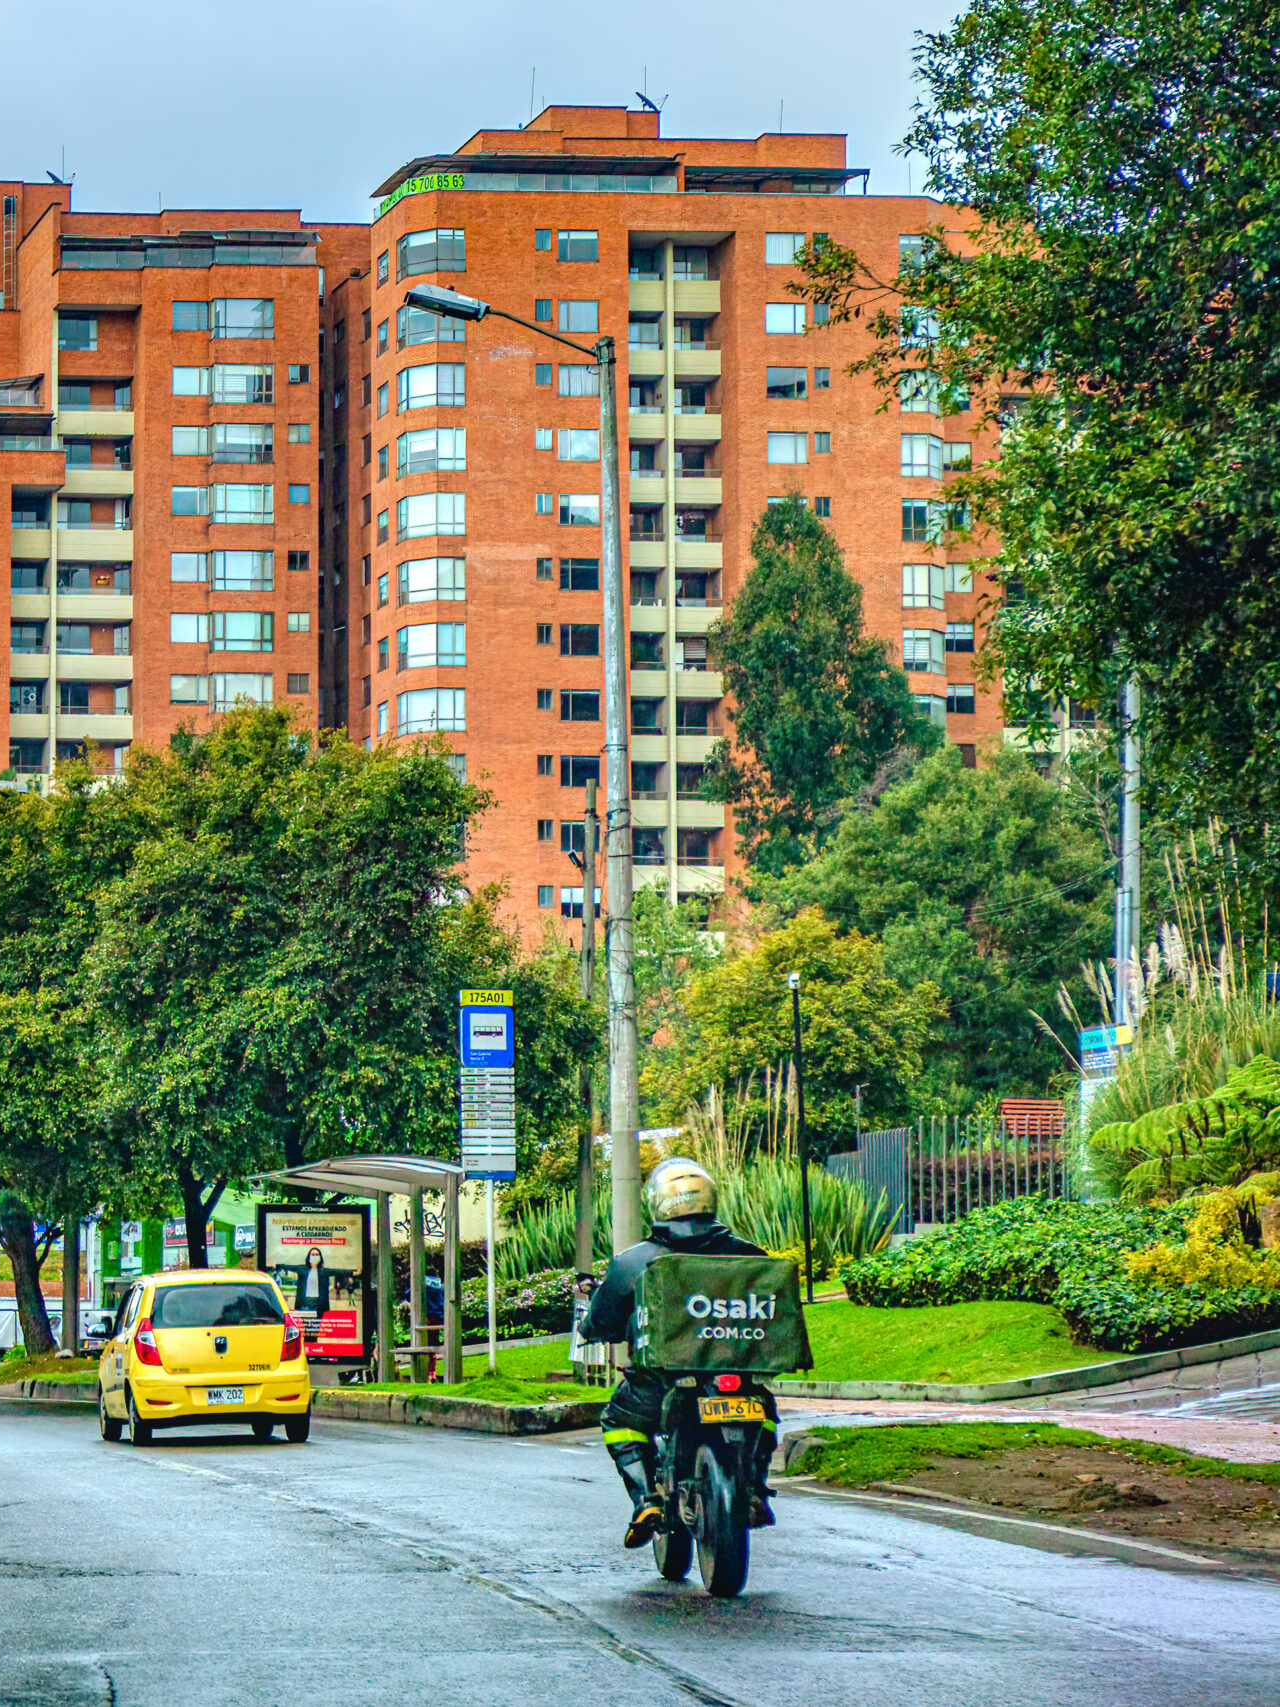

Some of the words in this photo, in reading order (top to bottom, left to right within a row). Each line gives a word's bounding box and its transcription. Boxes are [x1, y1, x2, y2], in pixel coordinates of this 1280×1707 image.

[419, 176, 434, 190] 700
[437, 174, 449, 188] 85
[452, 174, 465, 187] 63
[469, 992, 505, 1003] 175A01
[687, 1293, 777, 1320] Osaki
[697, 1326, 766, 1341] .COM.CO
[226, 1389, 243, 1400] 202
